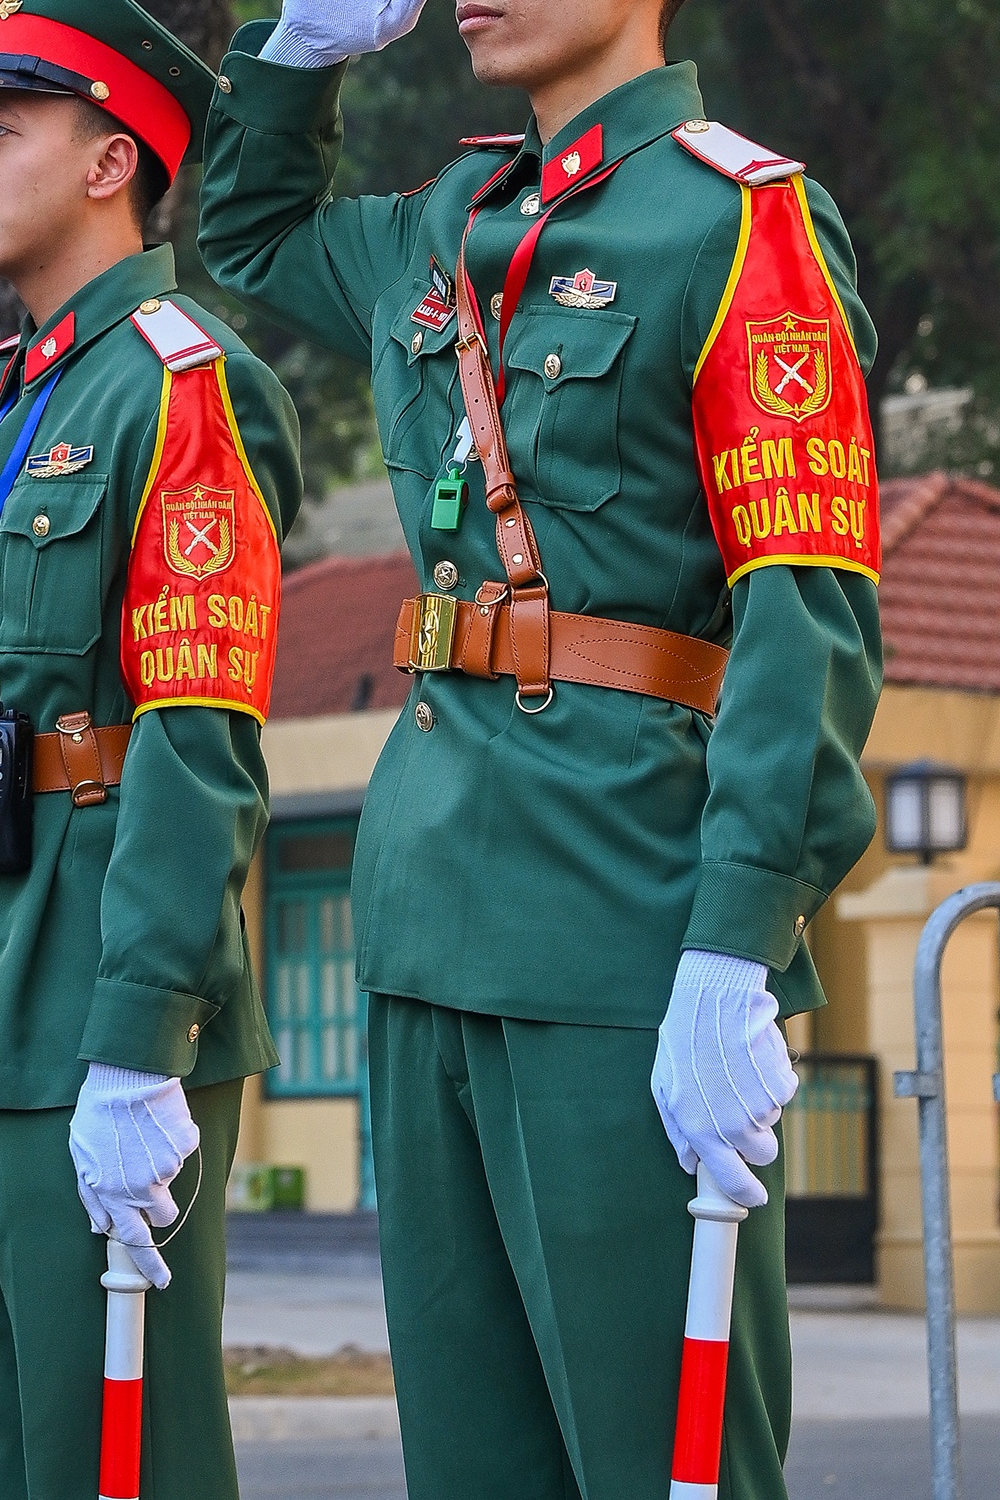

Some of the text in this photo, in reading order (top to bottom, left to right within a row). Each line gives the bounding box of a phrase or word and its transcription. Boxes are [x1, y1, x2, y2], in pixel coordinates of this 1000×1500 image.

[712, 427, 871, 494] KIỂM SOÁT
[732, 487, 867, 549] QUÂN SỰ
[131, 584, 271, 642] KIỂM SOÁT
[140, 638, 259, 694] QUÂN SỰ
